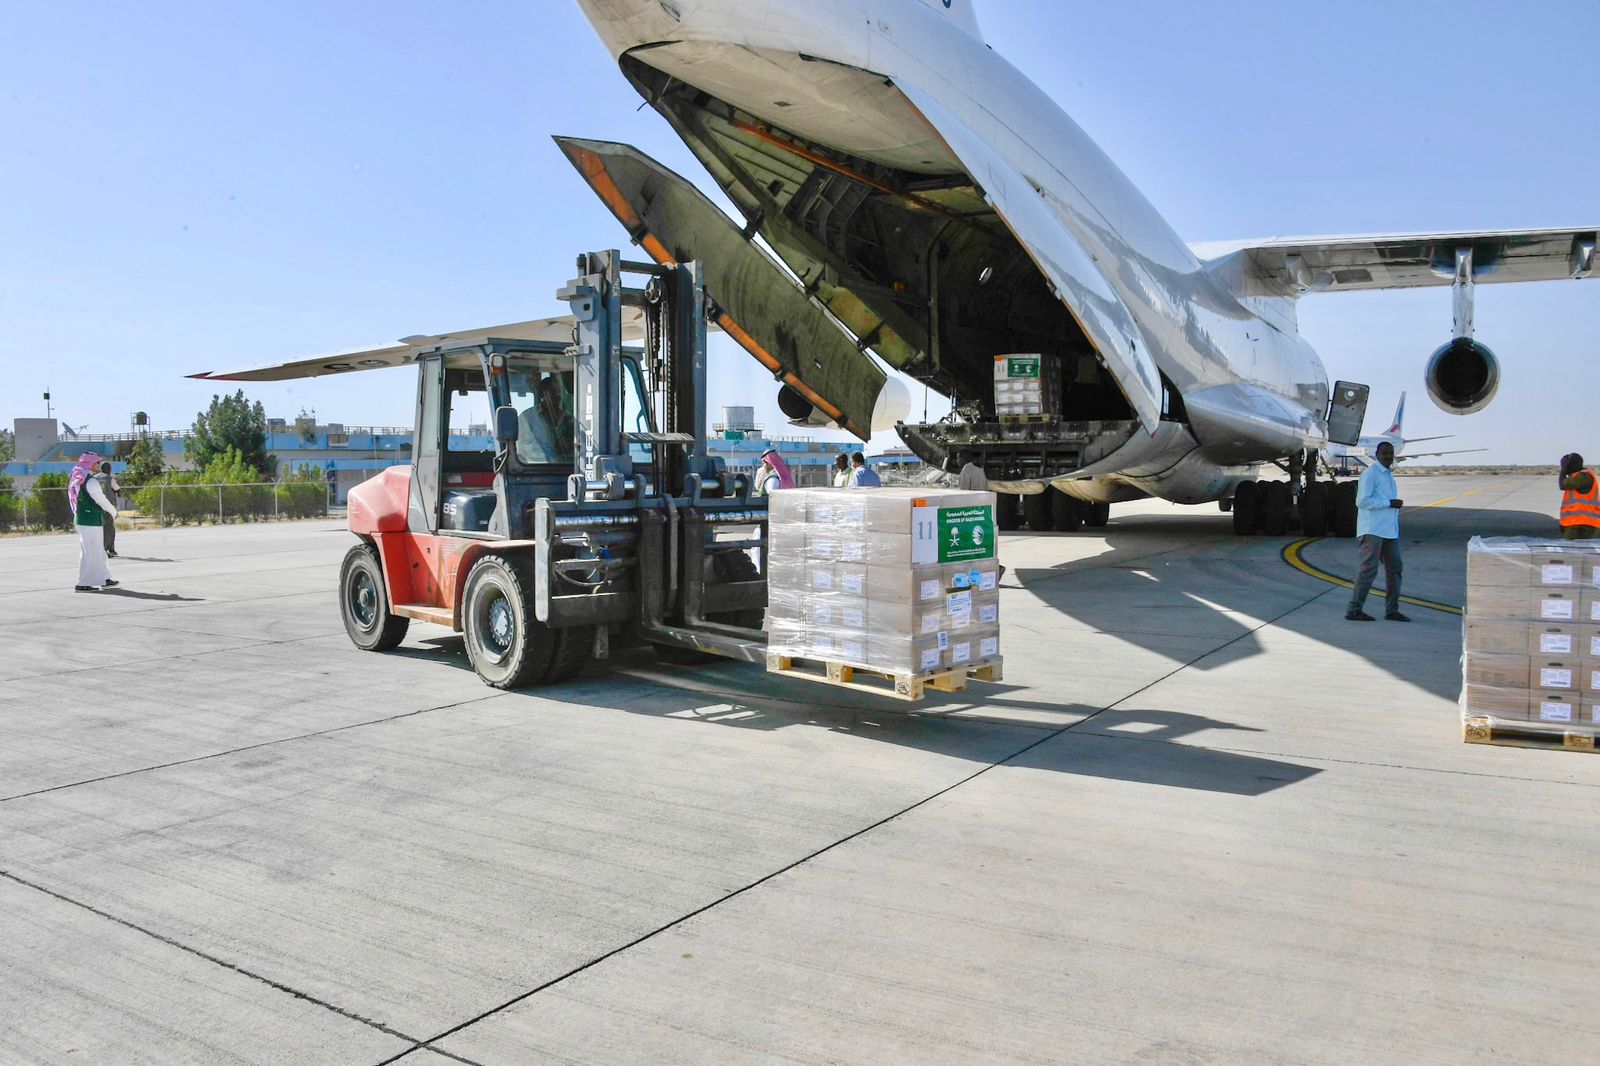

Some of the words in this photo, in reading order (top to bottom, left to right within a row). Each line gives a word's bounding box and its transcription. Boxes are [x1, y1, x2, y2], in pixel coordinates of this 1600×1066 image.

[585, 415, 593, 469] HELI
[443, 502, 457, 515] 85
[917, 520, 933, 540] 11
